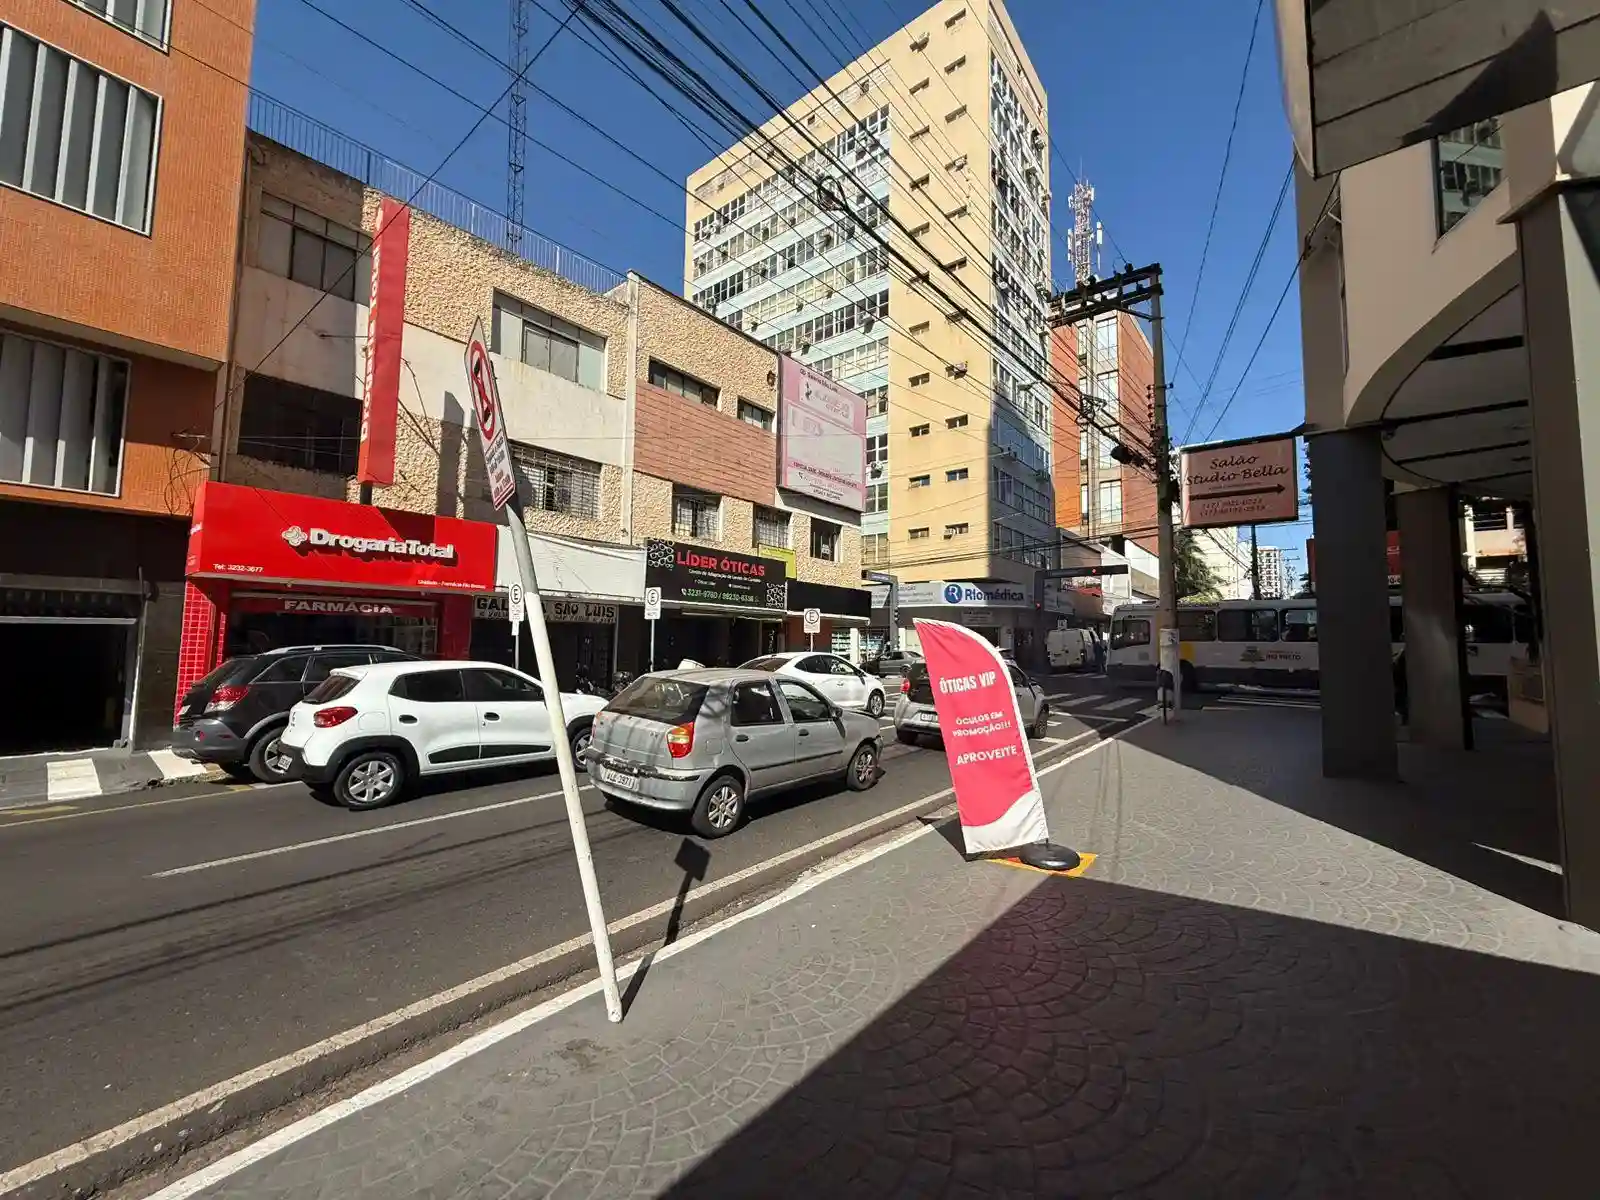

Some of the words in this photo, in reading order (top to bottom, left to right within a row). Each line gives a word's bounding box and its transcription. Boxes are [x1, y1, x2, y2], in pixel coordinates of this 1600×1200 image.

[676, 550, 717, 570] LÍDER
[720, 557, 765, 577] ÓTICAS
[939, 675, 977, 694] ÓTICAS
[979, 671, 997, 689] VIP
[952, 720, 1011, 737] PROMOÇÃO!!!
[955, 713, 989, 726] ÓCULOS
[990, 711, 1004, 719] EM
[956, 745, 1017, 765] APROVEITE
